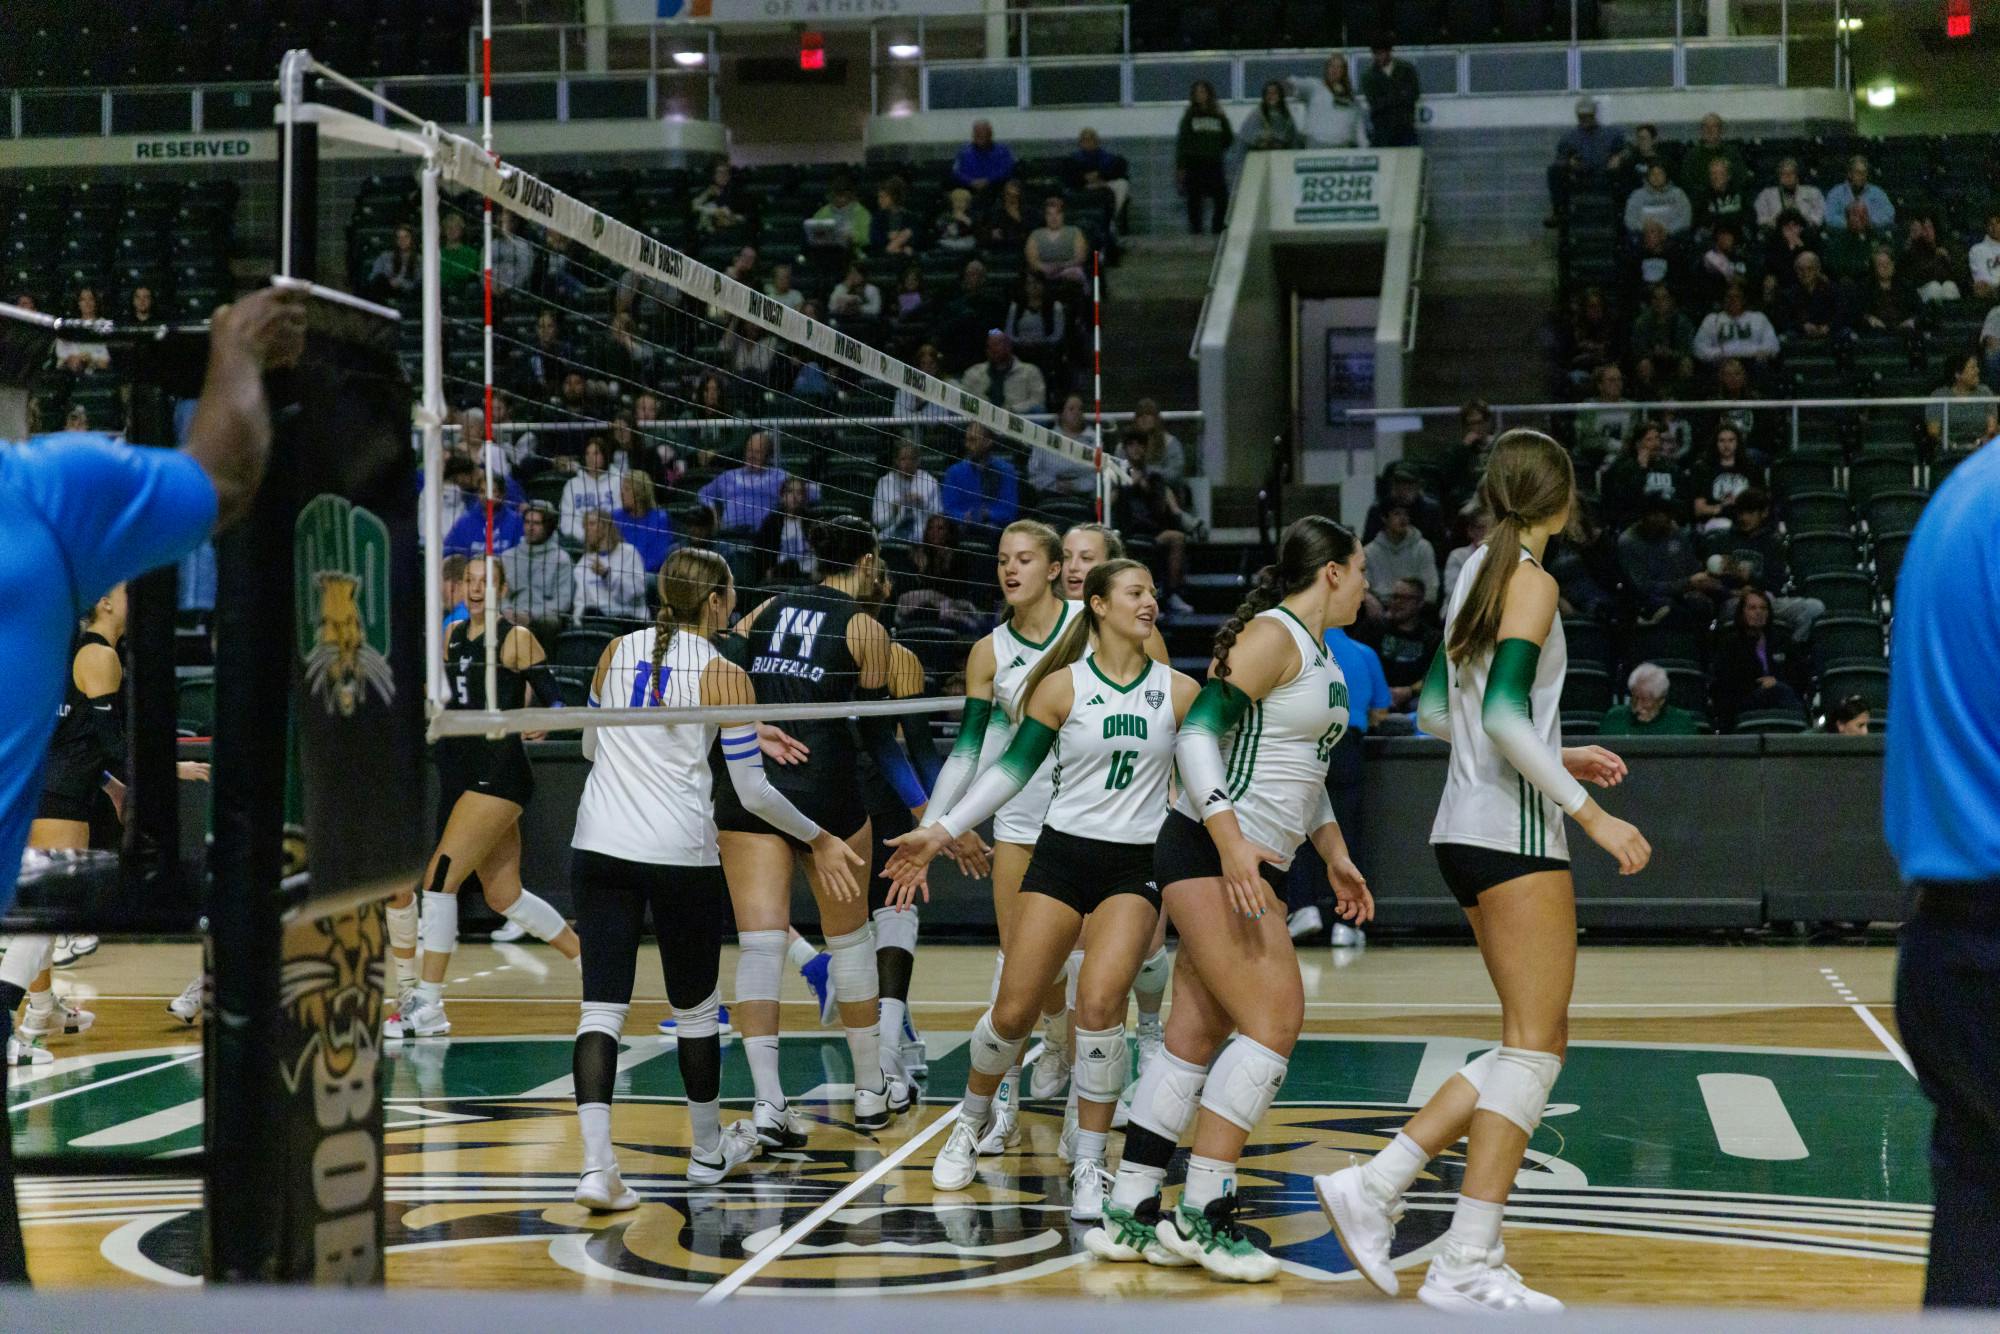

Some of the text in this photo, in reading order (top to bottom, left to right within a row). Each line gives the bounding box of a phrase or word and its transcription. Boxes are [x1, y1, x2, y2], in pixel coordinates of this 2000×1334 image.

[136, 141, 250, 159] RESERVED
[1302, 175, 1372, 189] ROHR
[1301, 189, 1372, 203] ROOM
[769, 606, 827, 659] 14
[752, 655, 825, 683] BUFFALO
[456, 675, 468, 705] 5
[1102, 713, 1148, 740] OHIO
[1104, 750, 1139, 790] 16
